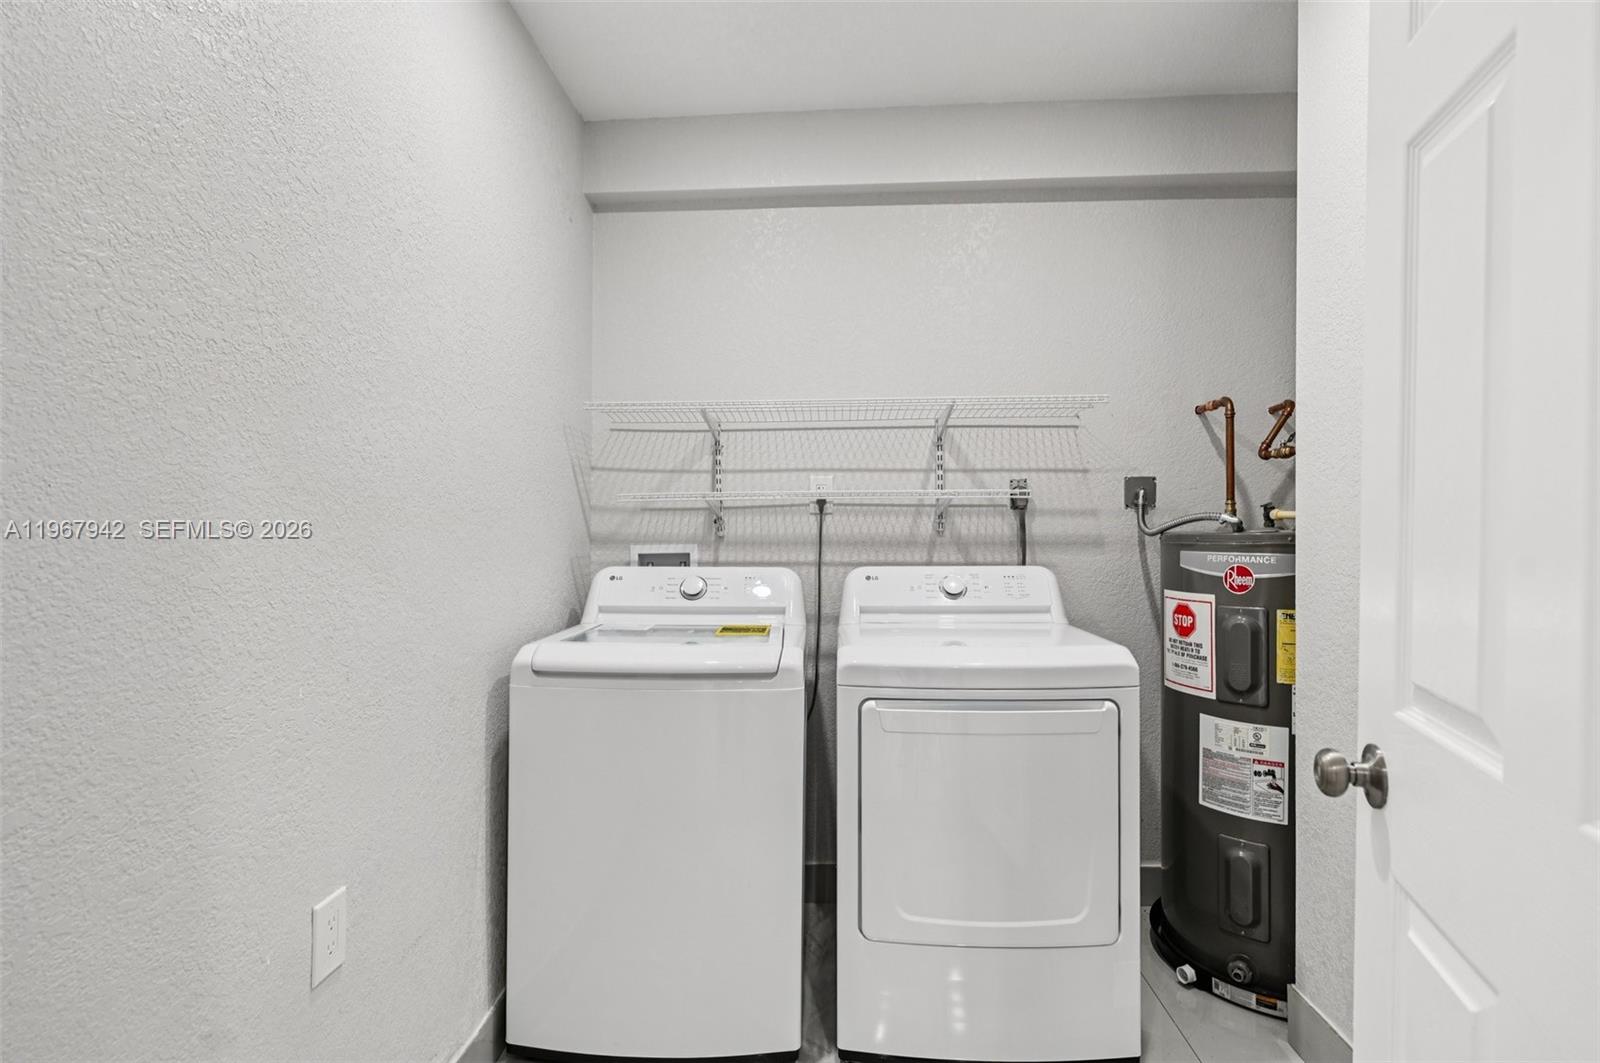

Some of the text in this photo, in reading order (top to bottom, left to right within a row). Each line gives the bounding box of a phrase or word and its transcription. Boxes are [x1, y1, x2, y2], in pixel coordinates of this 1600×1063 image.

[1207, 555, 1277, 564] PERFORMANCE
[1227, 565, 1253, 589] Rheem
[1174, 613, 1193, 627] STOP
